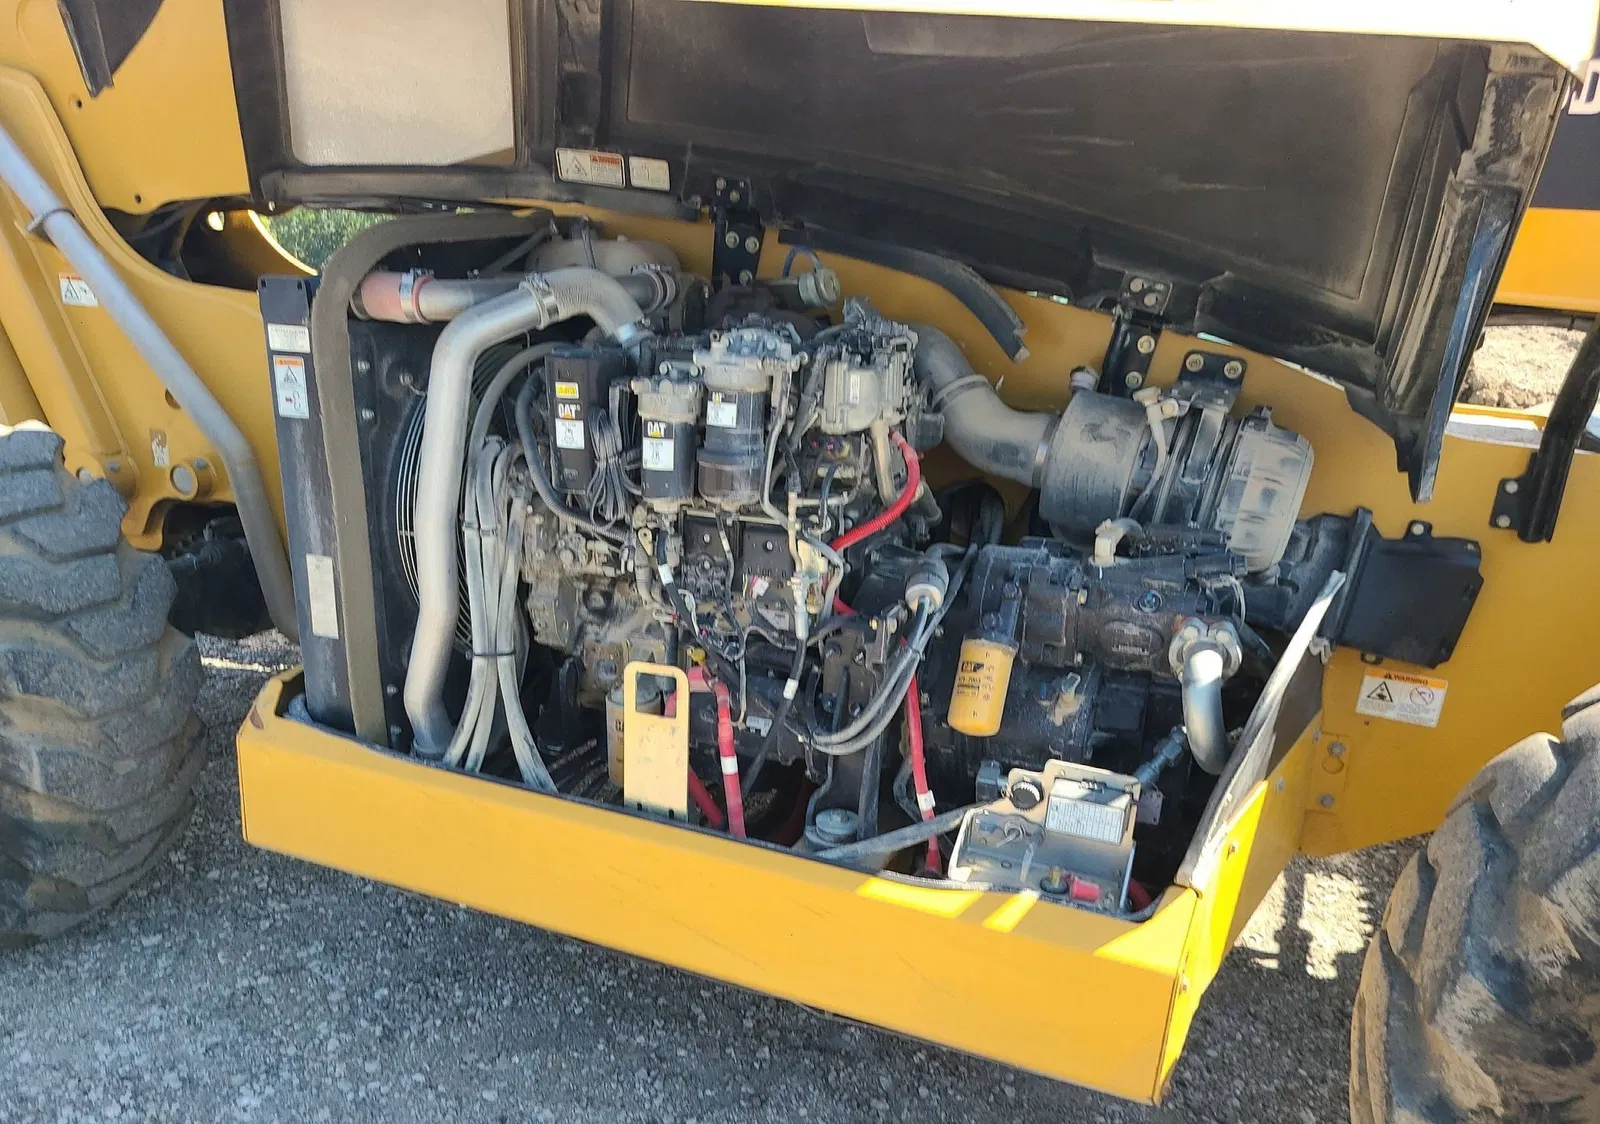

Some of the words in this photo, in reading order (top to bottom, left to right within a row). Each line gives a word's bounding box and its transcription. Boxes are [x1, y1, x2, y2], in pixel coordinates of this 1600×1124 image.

[558, 403, 577, 419] CAT
[647, 421, 666, 437] CAT
[1393, 673, 1429, 685] WARNING
